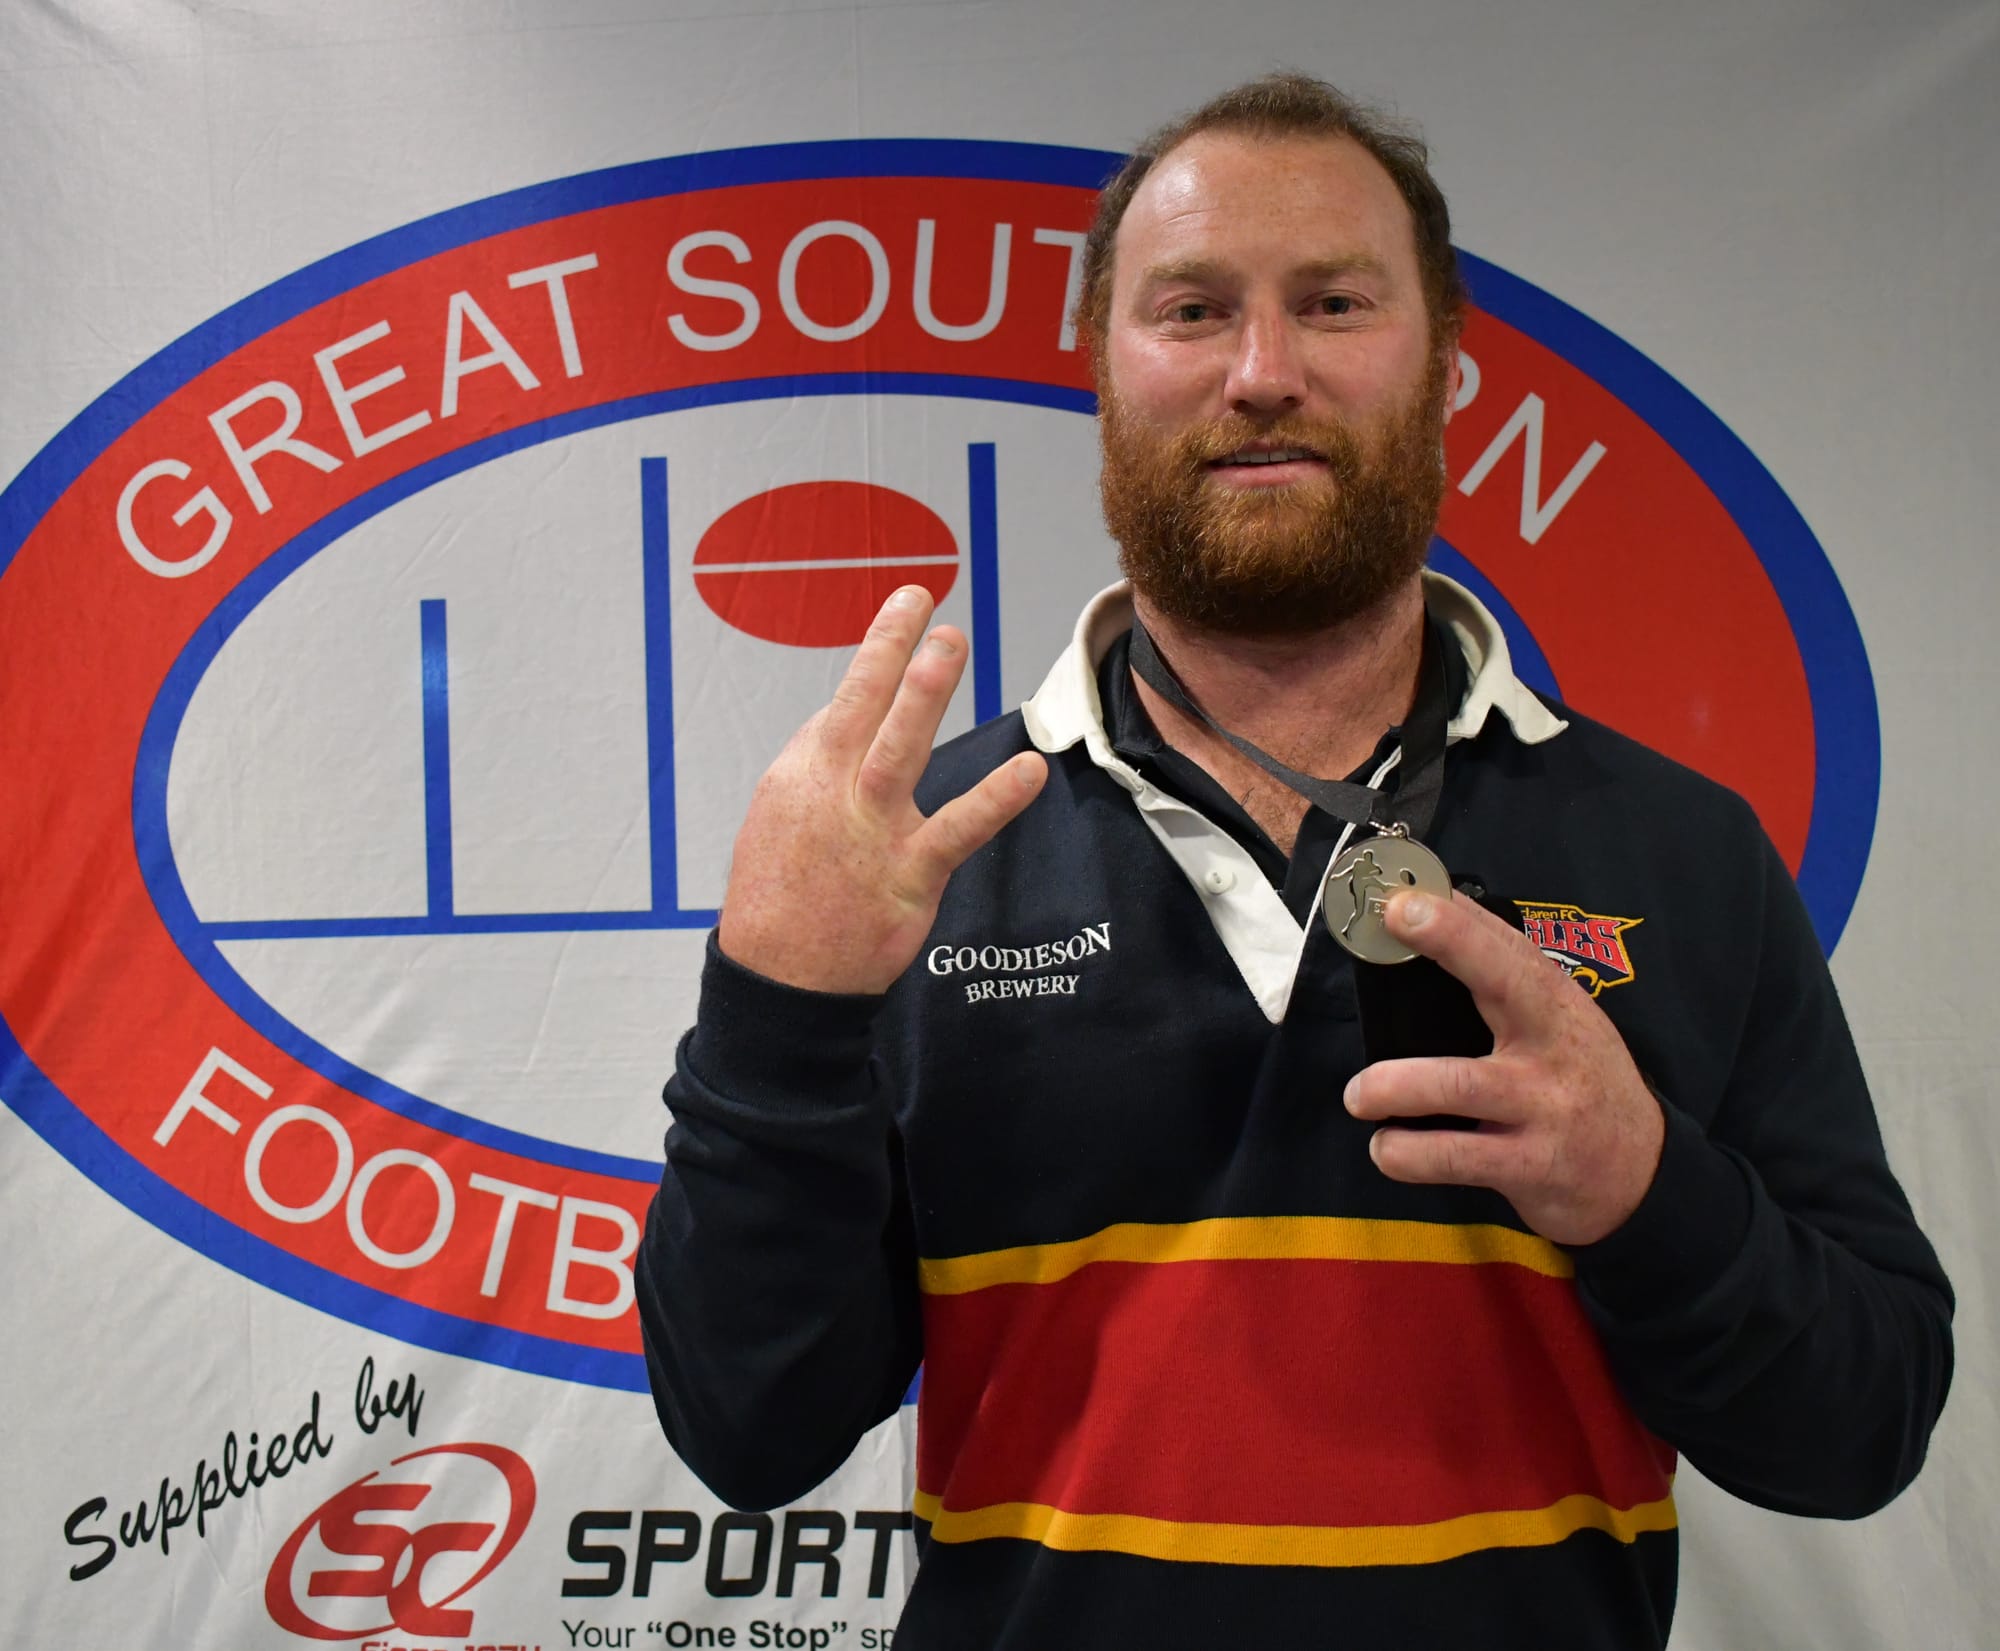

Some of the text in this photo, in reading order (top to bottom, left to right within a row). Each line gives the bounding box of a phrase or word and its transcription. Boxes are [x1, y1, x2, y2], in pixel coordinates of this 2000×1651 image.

[116, 218, 1609, 580] GREAT SOUTN
[927, 921, 1112, 976] GOODIESON
[1560, 909, 1579, 922] FC
[964, 974, 1081, 1004] BREWERY
[152, 1046, 642, 1320] FOOTB
[63, 1355, 425, 1582] Supplied by
[561, 1510, 913, 1599] SPORT
[561, 1619, 636, 1649] Your
[647, 1621, 740, 1649] “One
[748, 1620, 848, 1651] Stop”
